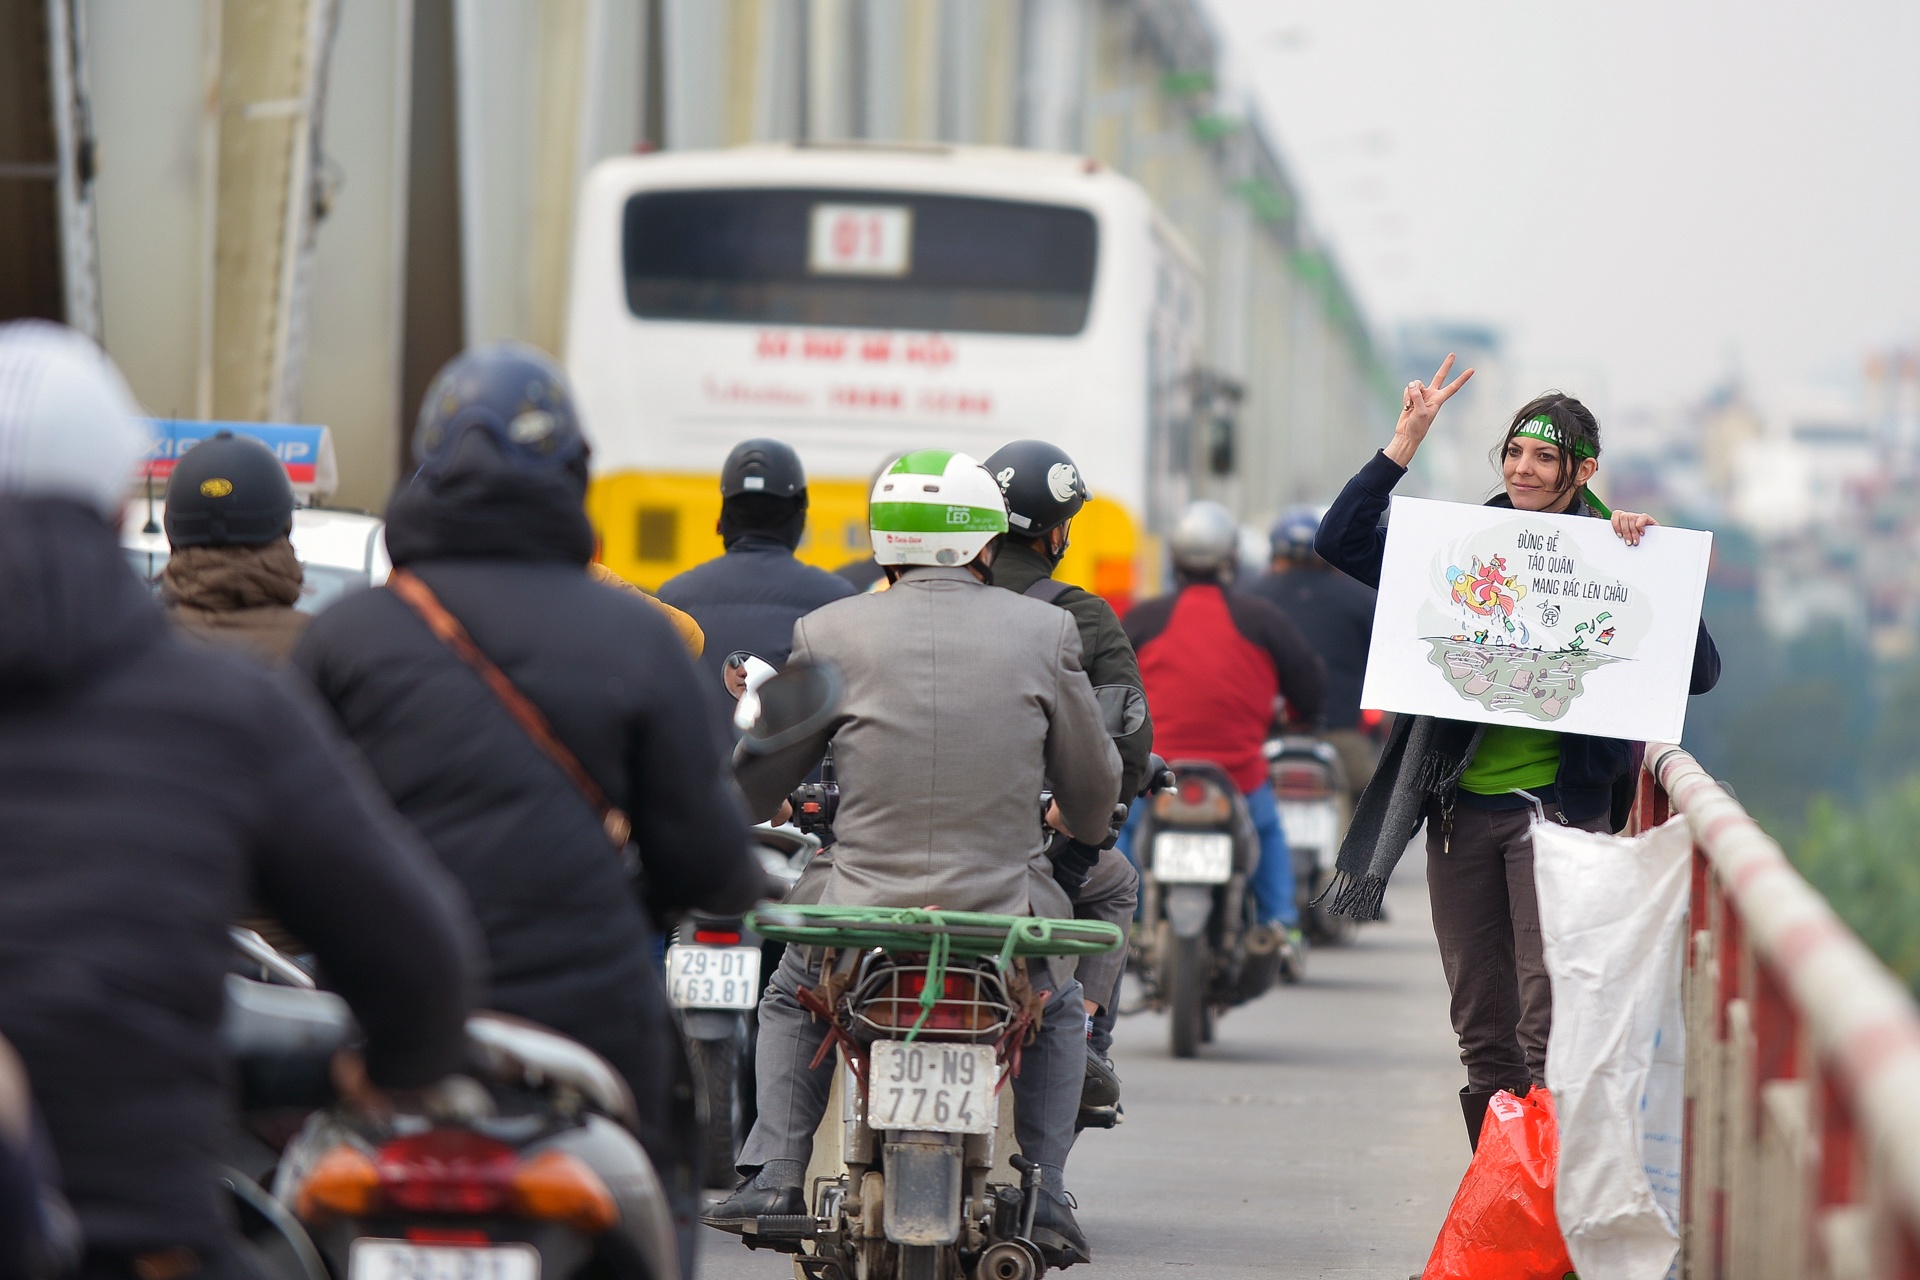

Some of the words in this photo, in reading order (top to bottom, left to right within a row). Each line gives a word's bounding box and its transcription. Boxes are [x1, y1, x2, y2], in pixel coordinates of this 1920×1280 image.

[945, 511, 971, 525] LED
[1517, 529, 1544, 551] ĐỪNG
[1546, 529, 1560, 552] ĐỂ
[1527, 552, 1545, 571] TÁO
[1547, 555, 1575, 575] QUÂN
[1532, 577, 1560, 595] MANG
[1562, 577, 1581, 598] RÁC
[1582, 580, 1601, 600] LÊN
[1603, 580, 1629, 603] CHẦU
[681, 952, 745, 977] 29-D1
[890, 1048, 976, 1086] 30-N9
[888, 1086, 972, 1126] 7764
